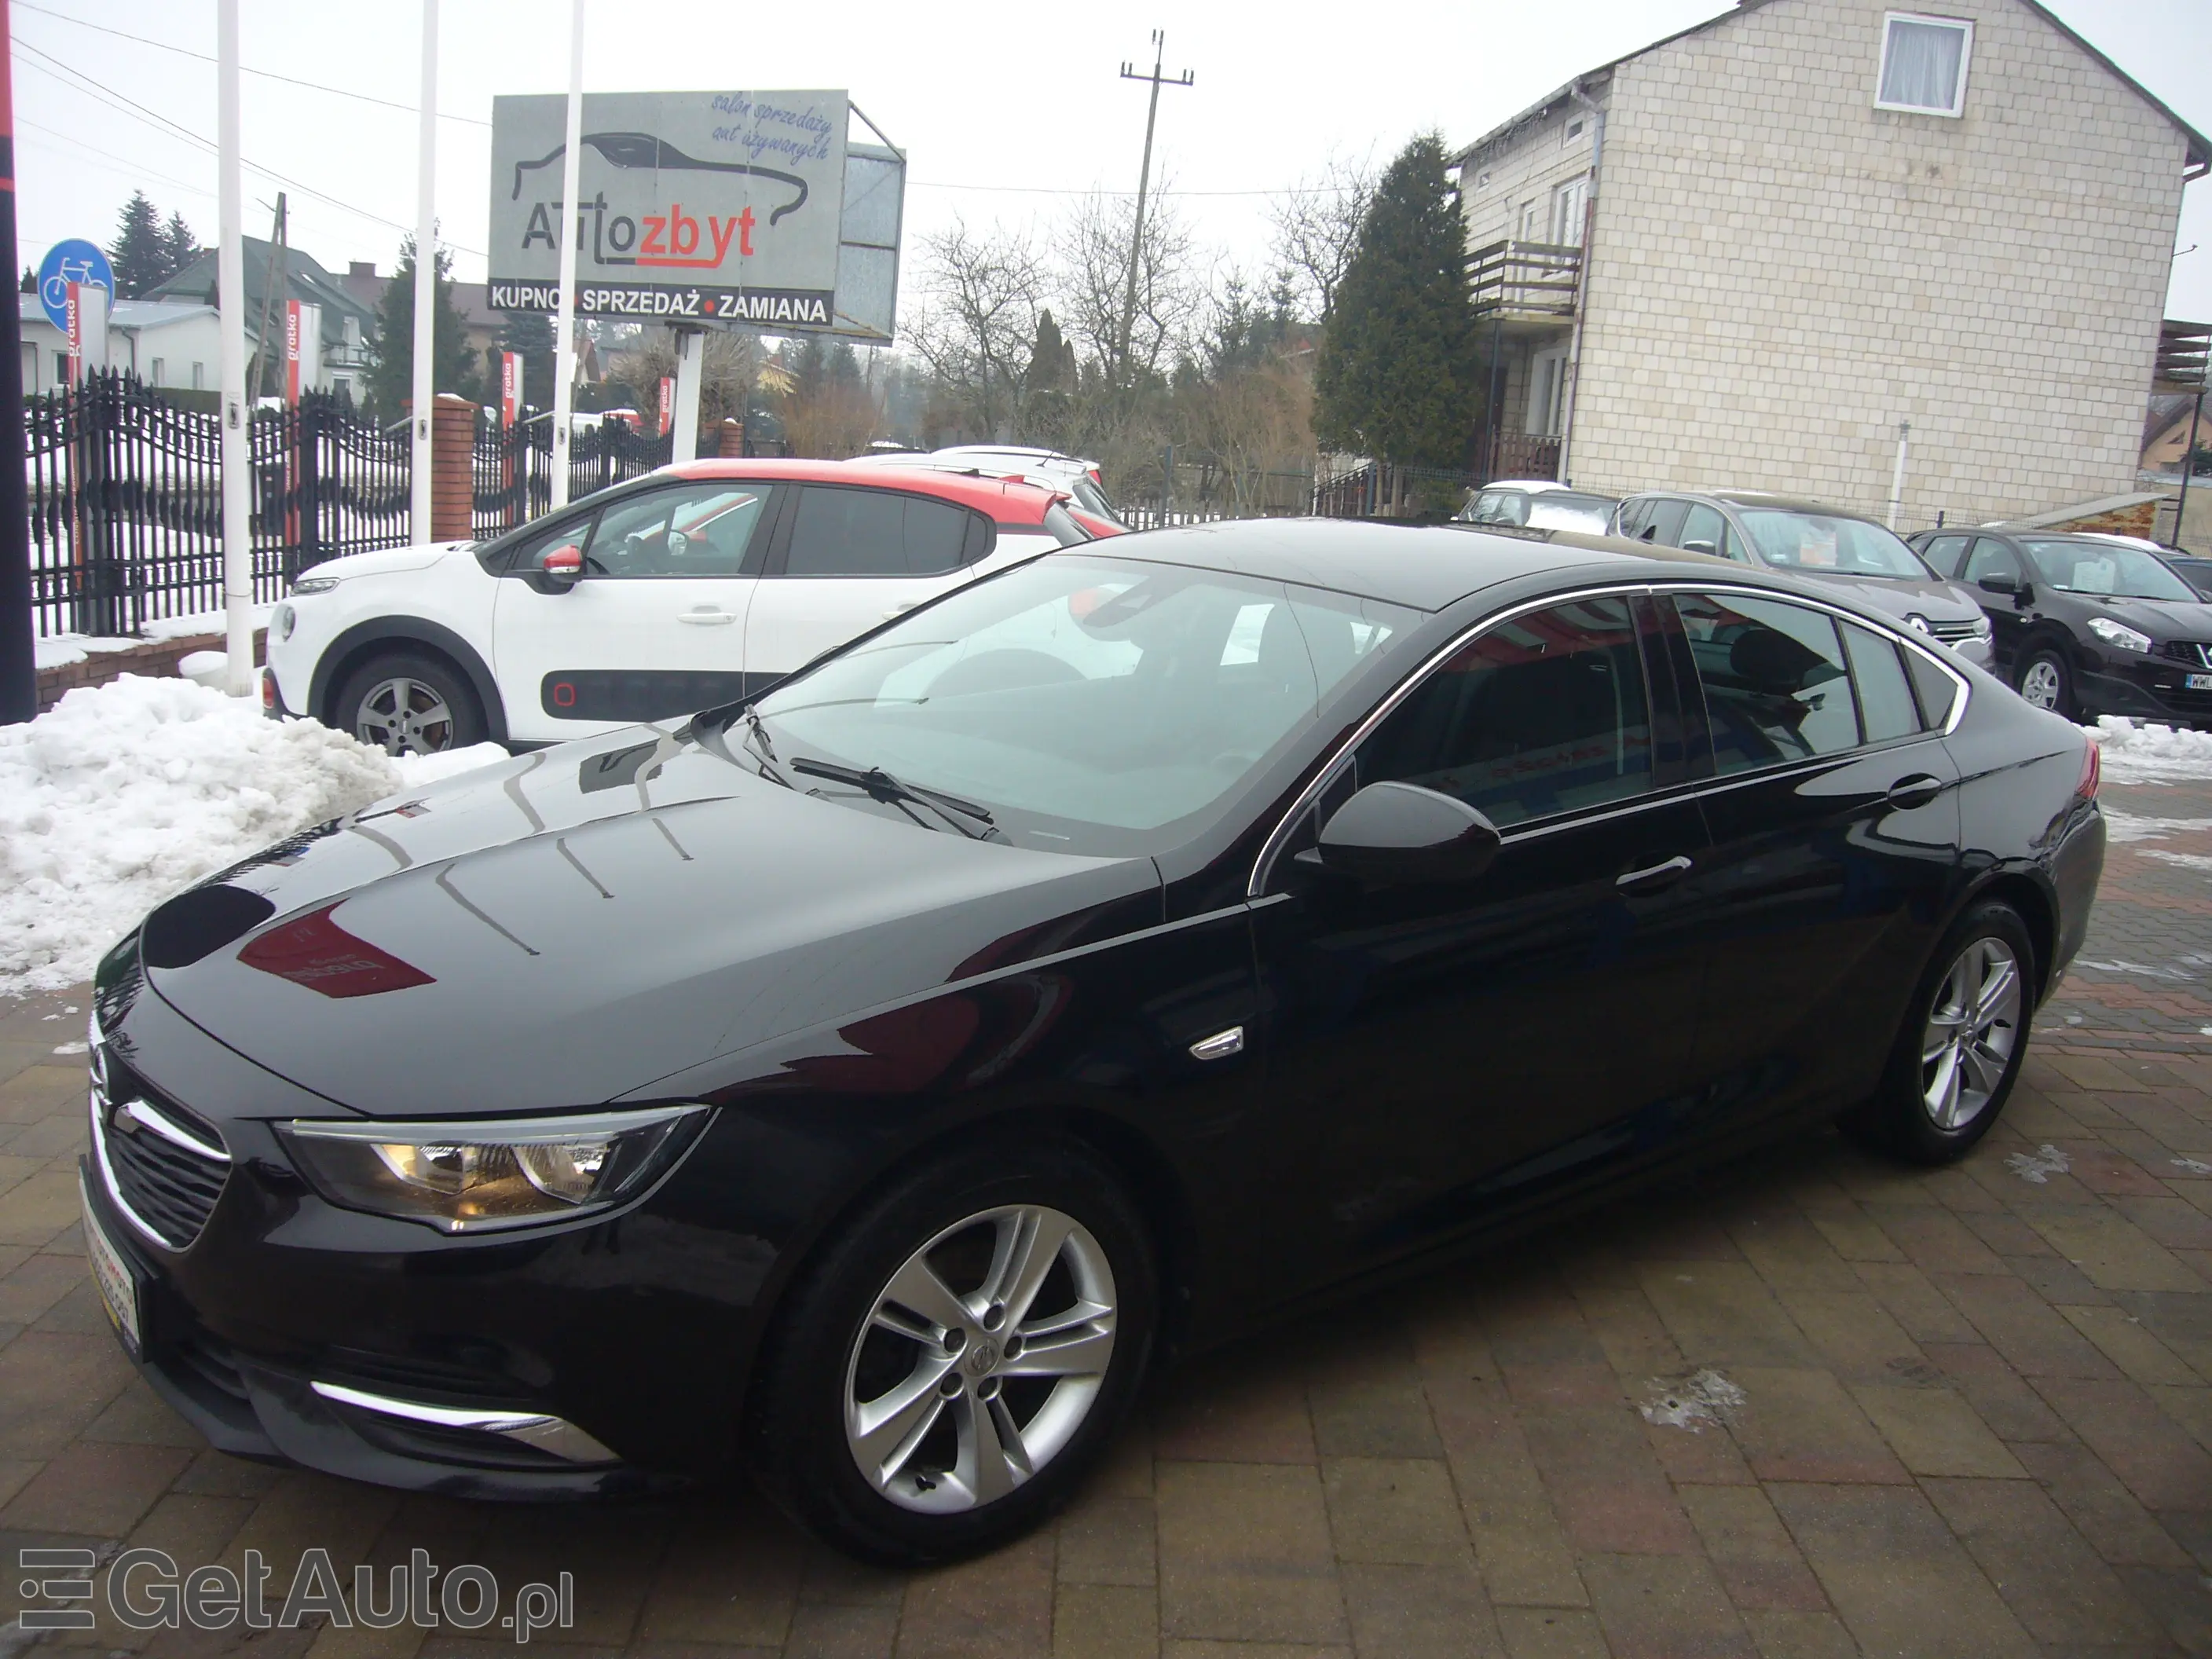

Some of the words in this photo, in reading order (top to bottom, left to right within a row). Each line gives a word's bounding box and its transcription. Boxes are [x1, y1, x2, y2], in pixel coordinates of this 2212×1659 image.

[711, 91, 752, 115] salon
[753, 104, 833, 143] sprzedaży
[712, 124, 742, 141] aut
[742, 130, 832, 166] używanych
[68, 299, 81, 357] gratka
[582, 288, 701, 316] SPRZEDAŻ
[718, 295, 828, 323] ZAMIANA
[288, 313, 299, 361] gratka
[505, 362, 515, 399] gratka
